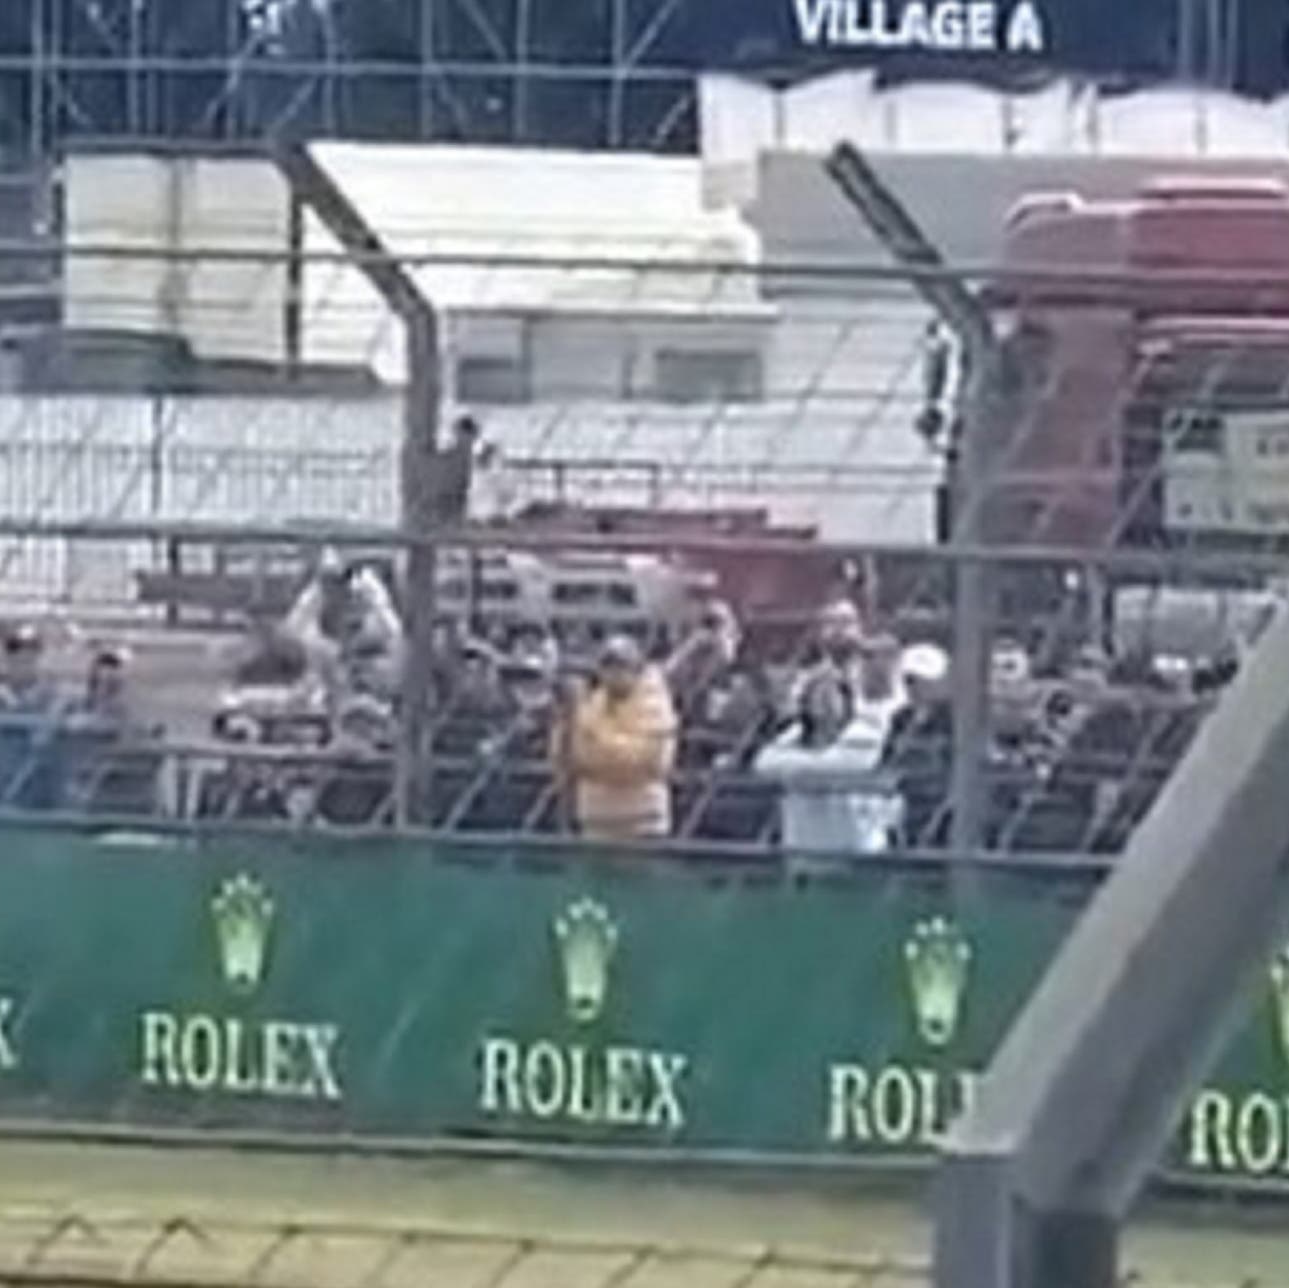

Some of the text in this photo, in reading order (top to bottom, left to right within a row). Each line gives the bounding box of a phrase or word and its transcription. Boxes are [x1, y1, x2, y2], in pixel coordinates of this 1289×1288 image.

[795, 0, 1043, 50] VILLAGE A
[141, 1012, 342, 1099] ROLEX
[482, 1037, 687, 1128] ROLEX
[829, 1062, 976, 1142] ROL
